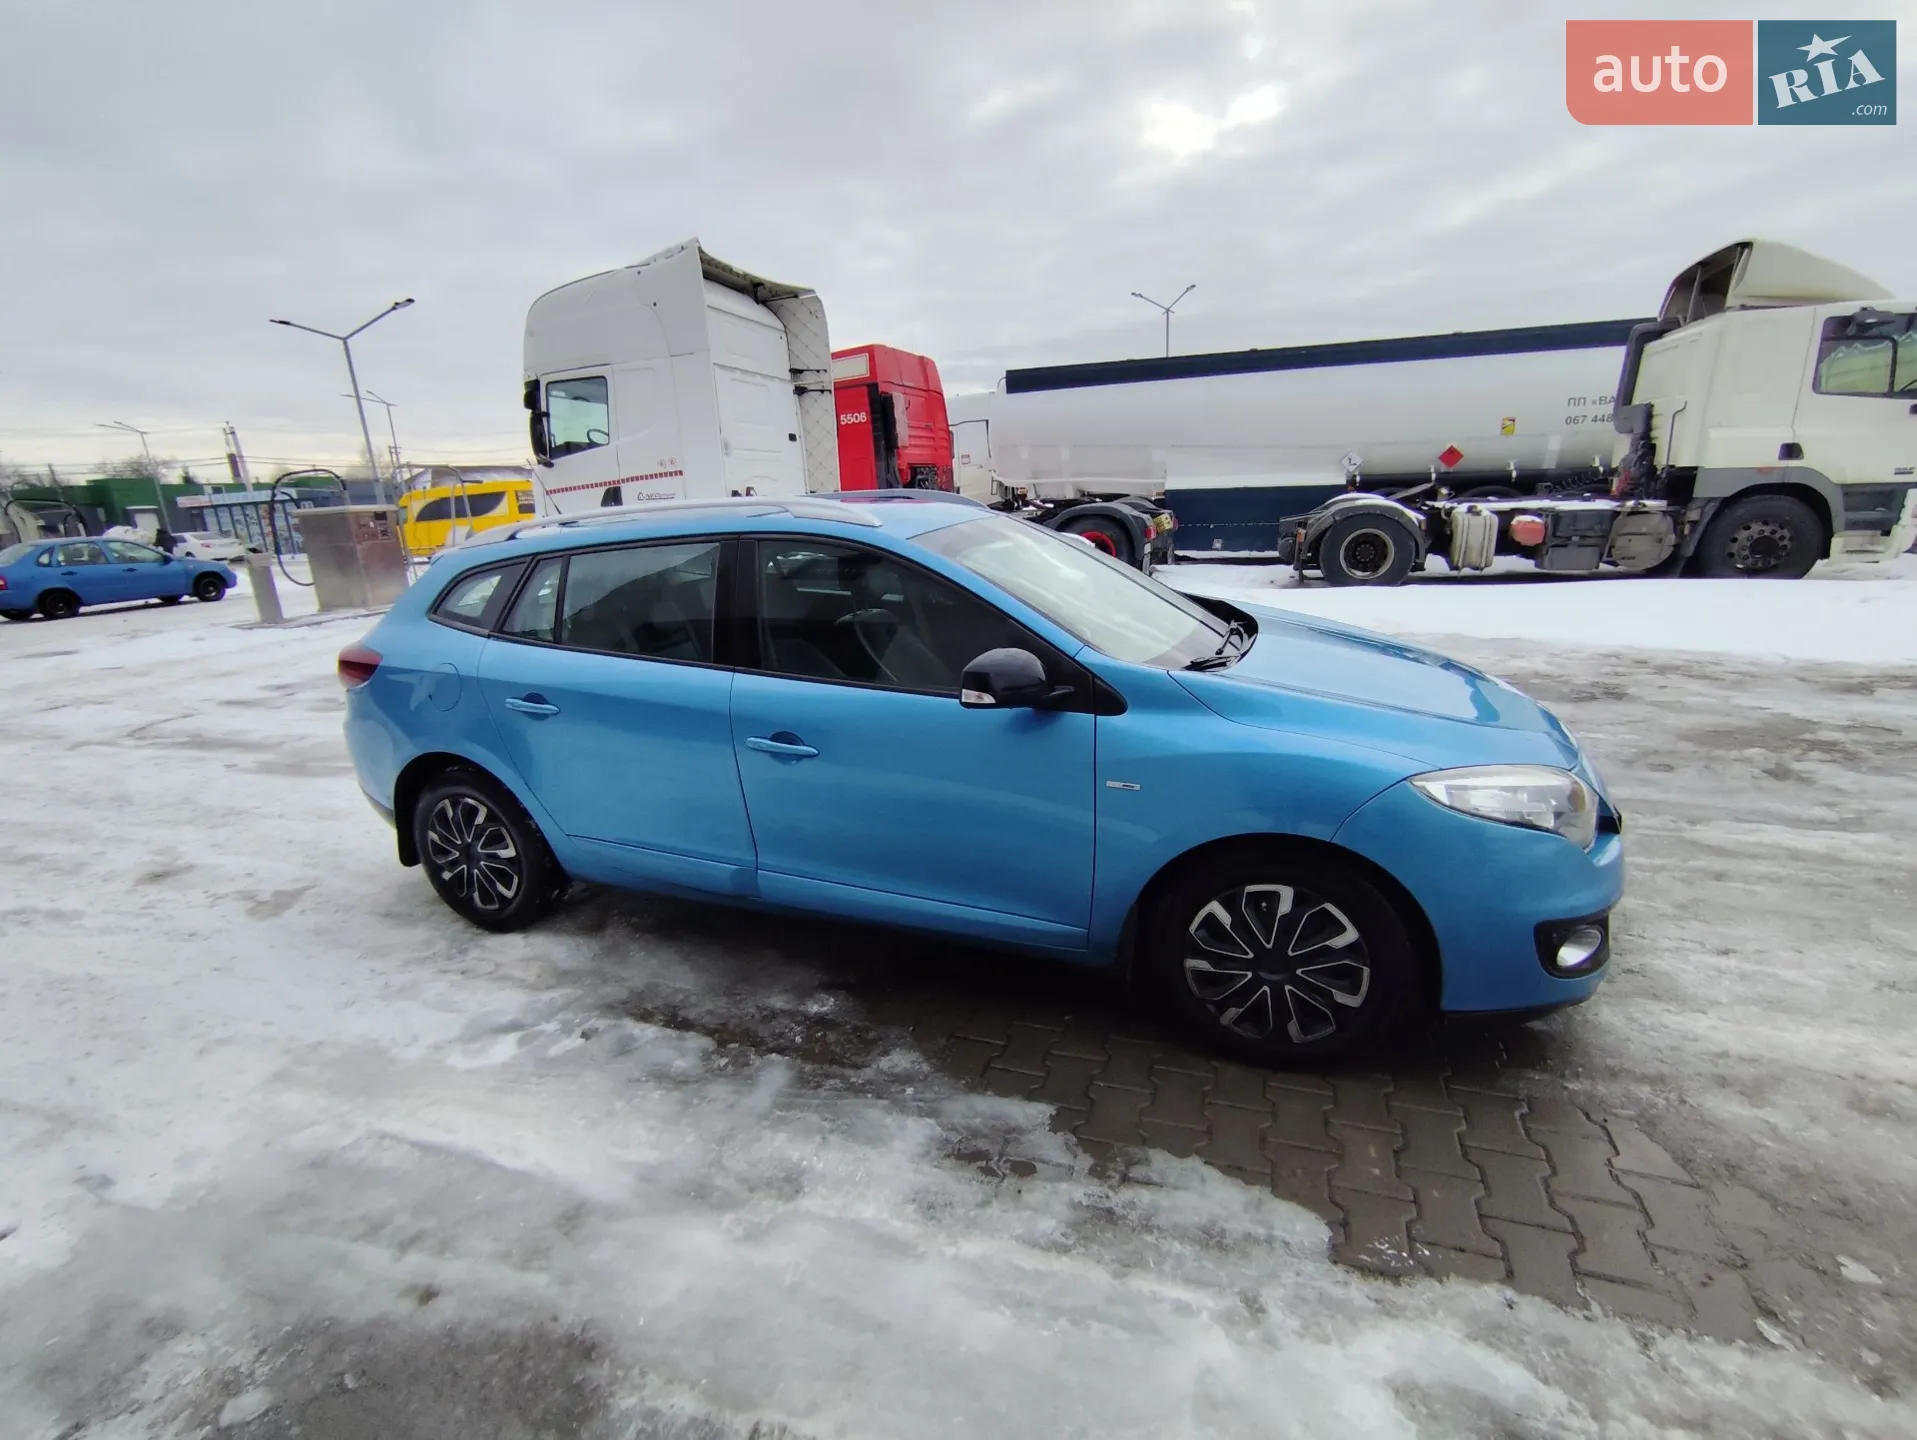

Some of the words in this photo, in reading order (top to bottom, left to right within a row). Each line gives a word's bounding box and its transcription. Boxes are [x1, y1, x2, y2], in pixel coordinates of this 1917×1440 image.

[1567, 397, 1587, 407] ПП
[840, 412, 867, 425] 5506
[1565, 415, 1587, 425] 067
[1591, 414, 1613, 423] 448
